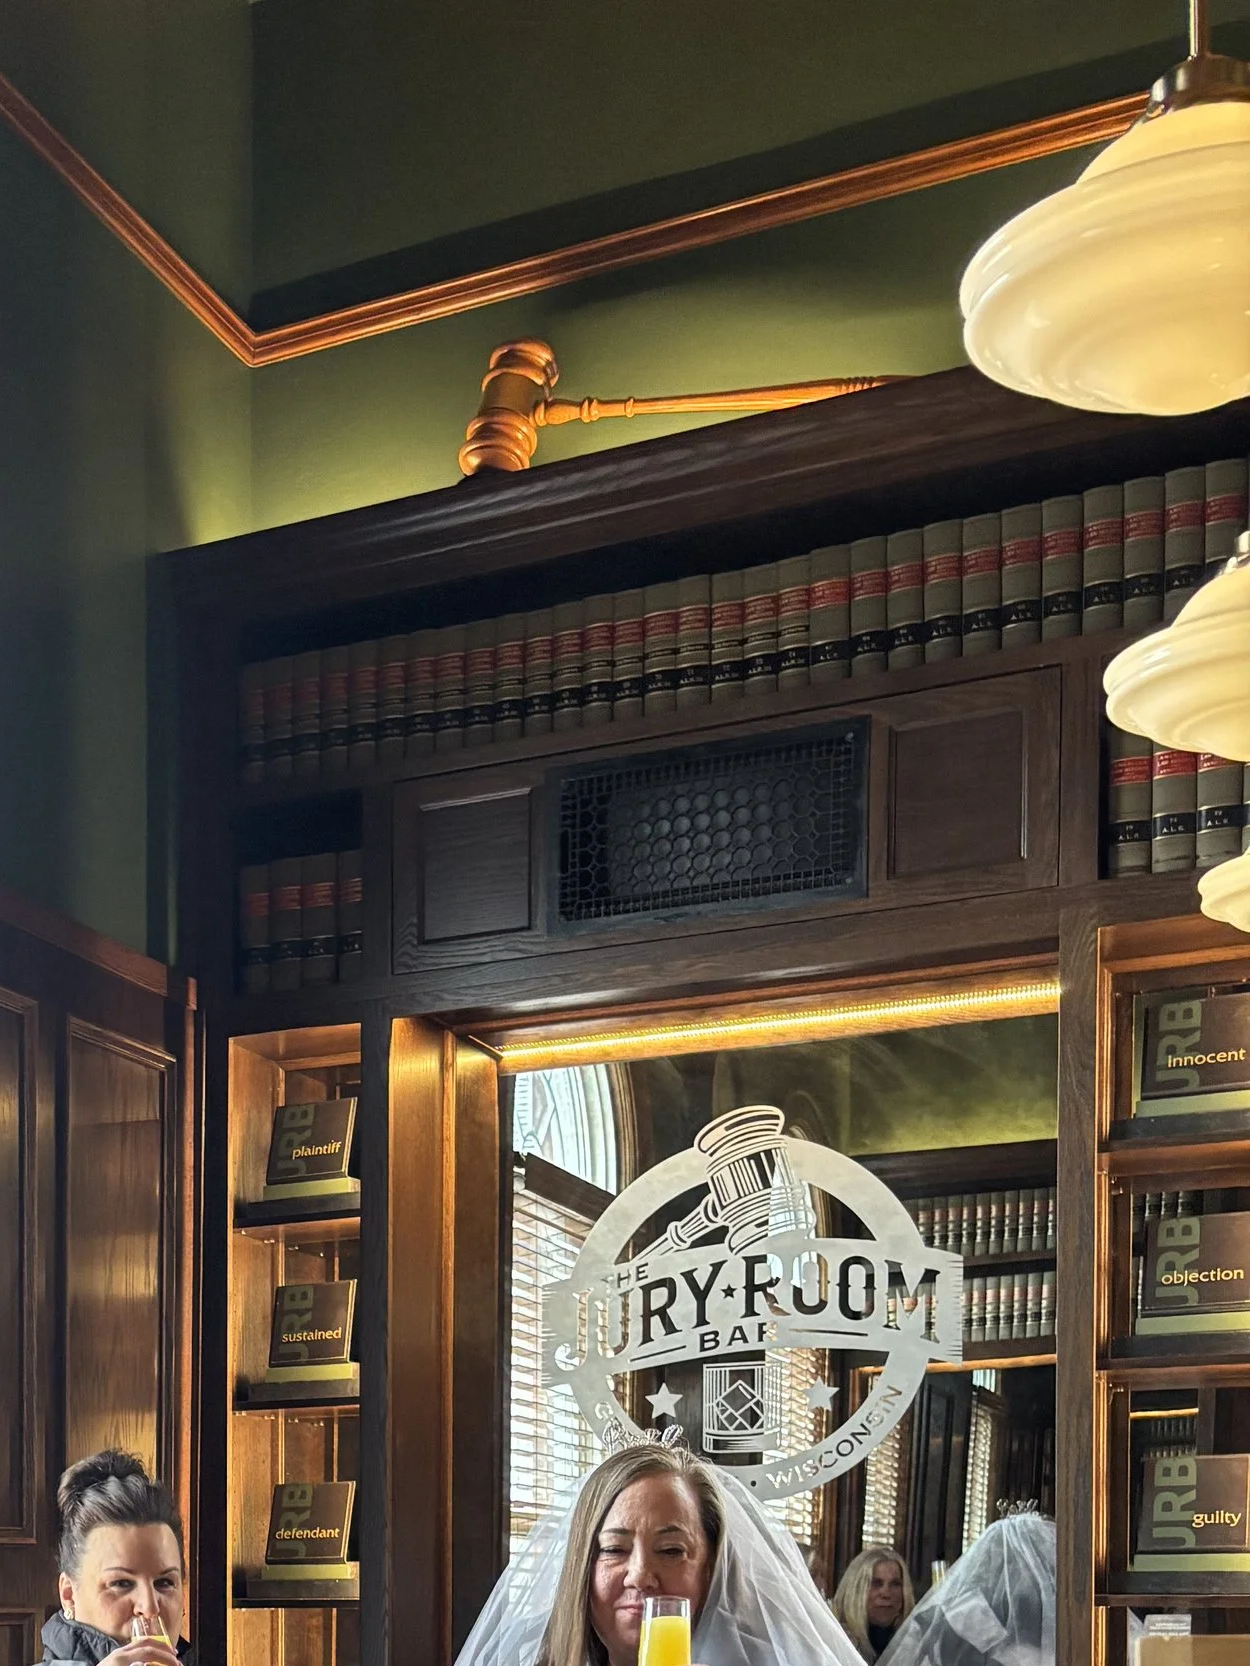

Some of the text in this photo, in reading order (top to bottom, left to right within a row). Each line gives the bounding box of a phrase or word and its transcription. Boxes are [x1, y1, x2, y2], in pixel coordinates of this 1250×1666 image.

[1167, 1047, 1247, 1068] innocent
[292, 1139, 342, 1161] plaintiff
[1161, 1267, 1245, 1287] objection
[554, 1249, 943, 1372] JURY ROOM
[281, 1326, 342, 1343] sustained
[699, 1319, 779, 1353] BAR
[765, 1384, 903, 1489] WISCONSIN
[1152, 1457, 1198, 1548] JRB
[1192, 1509, 1242, 1528] guilty
[275, 1526, 340, 1541] defendant
